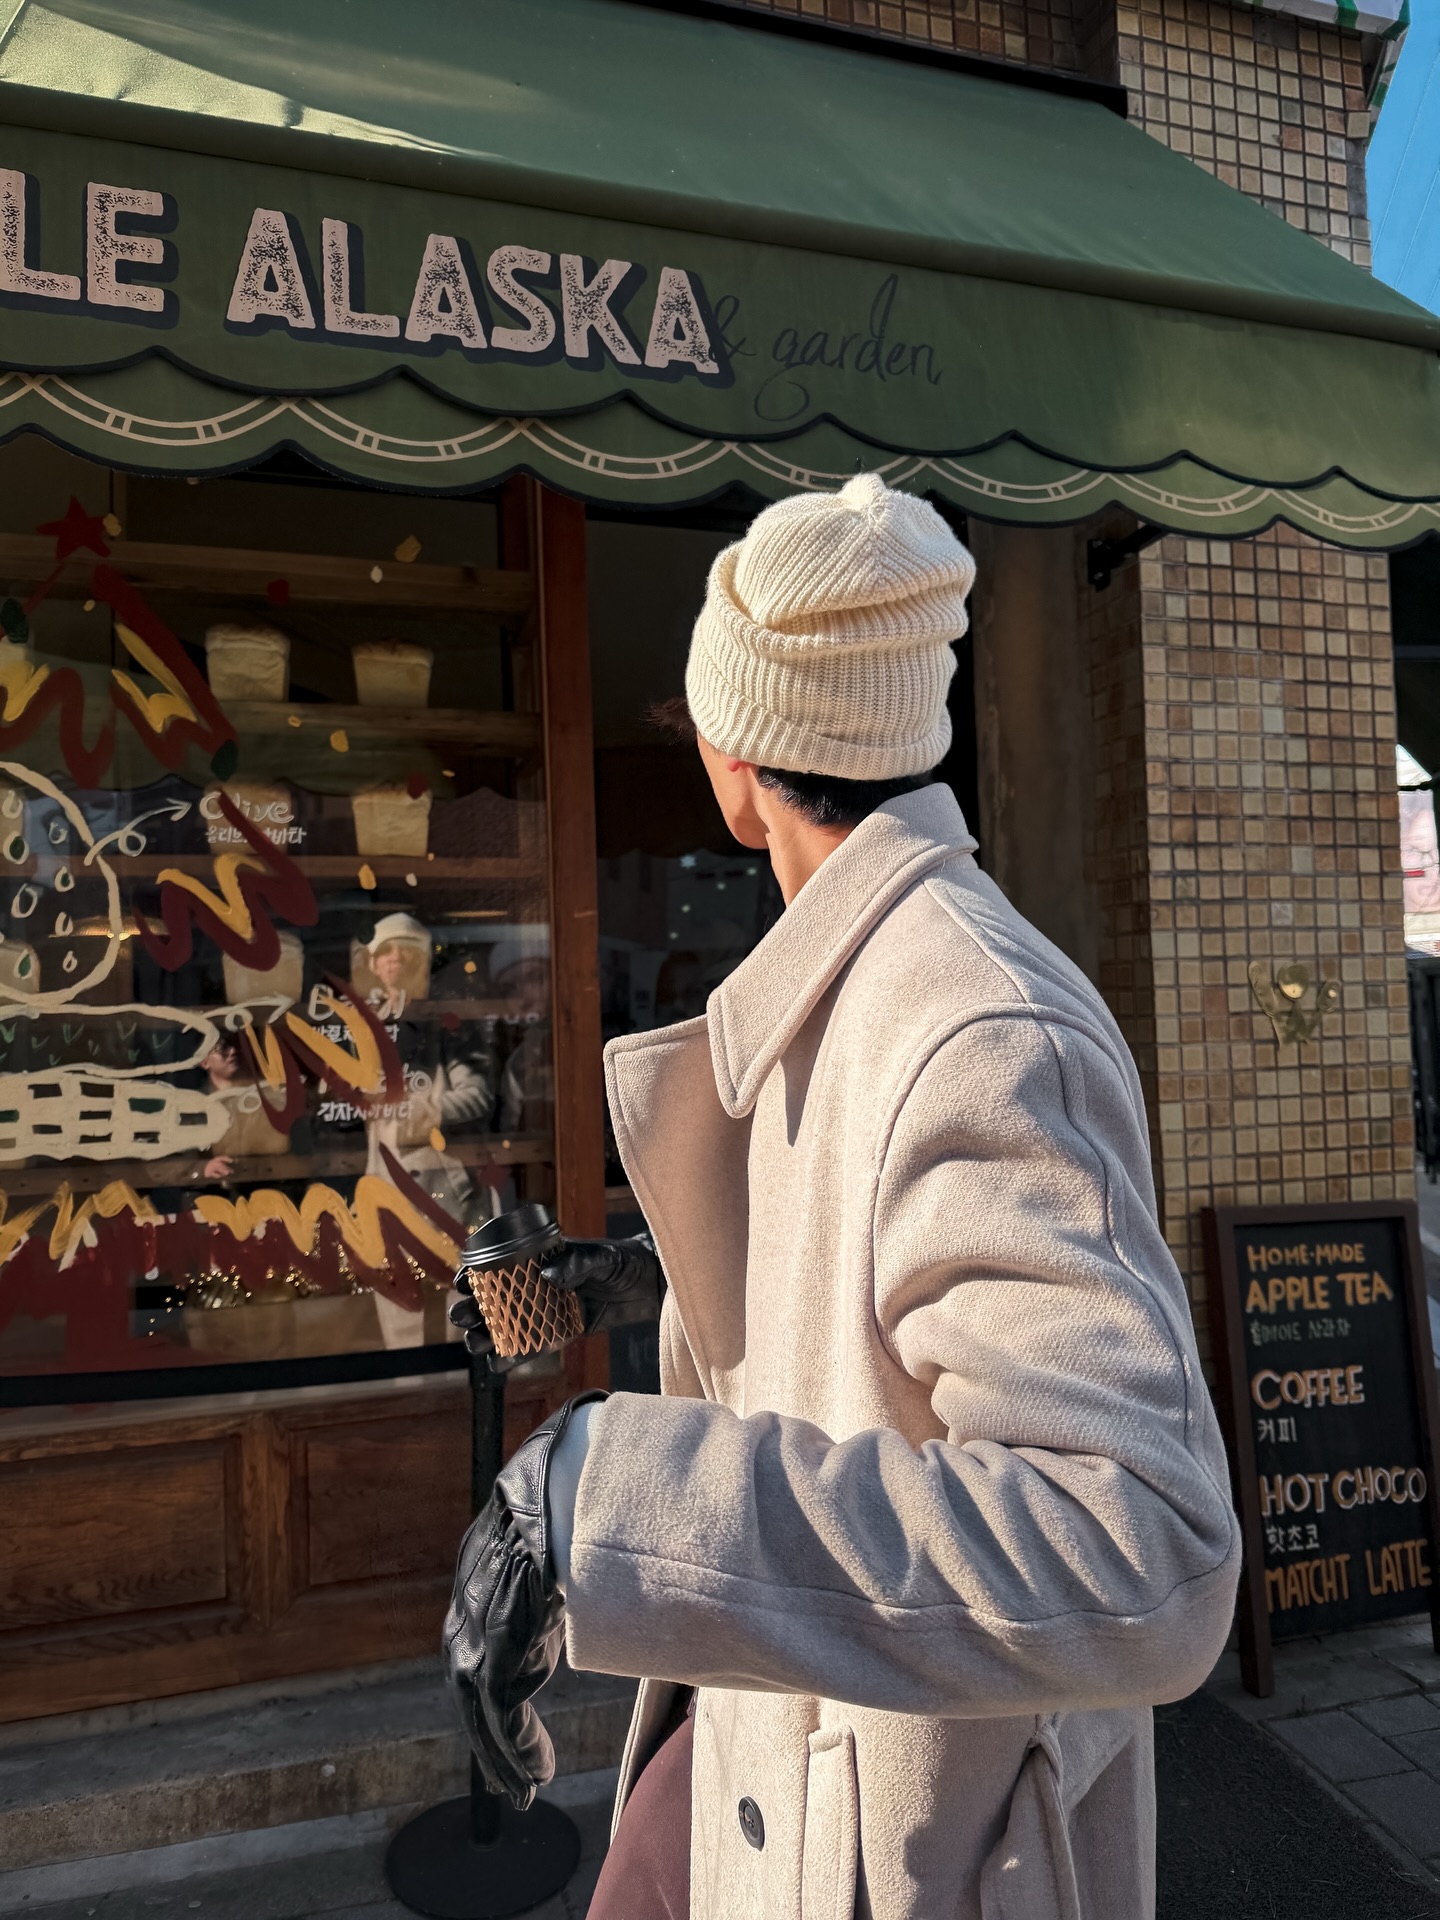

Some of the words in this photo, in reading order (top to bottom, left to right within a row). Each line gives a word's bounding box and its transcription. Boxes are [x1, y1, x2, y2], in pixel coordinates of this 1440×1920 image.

[226, 207, 720, 374] ALASKA
[752, 272, 944, 422] garden
[1245, 1275, 1331, 1314] APPLE
[1336, 1270, 1394, 1307] TEA
[1251, 1364, 1365, 1410] COFFEE
[1257, 1417, 1298, 1444] 커피
[1260, 1472, 1329, 1517] HOT
[1333, 1466, 1428, 1510] CHOCO
[1265, 1524, 1320, 1554] 핫초코
[1366, 1538, 1432, 1597] LATTE
